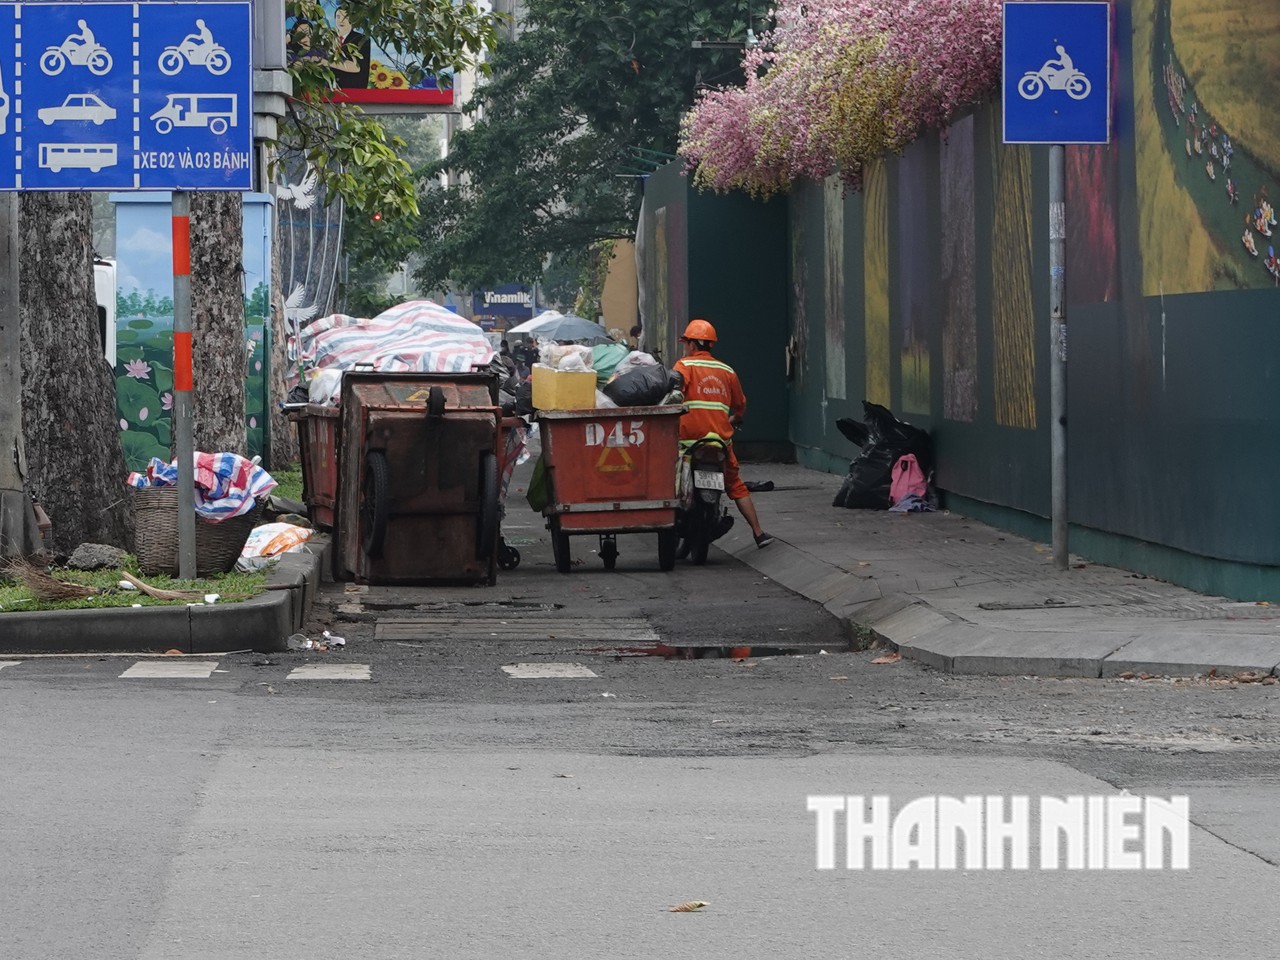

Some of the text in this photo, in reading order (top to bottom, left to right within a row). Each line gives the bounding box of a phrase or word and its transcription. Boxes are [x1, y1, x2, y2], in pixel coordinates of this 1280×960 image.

[141, 146, 249, 169] XE 02 VÀ 03 BÁNH
[484, 291, 531, 303] Vinamilk
[585, 421, 645, 447] D45
